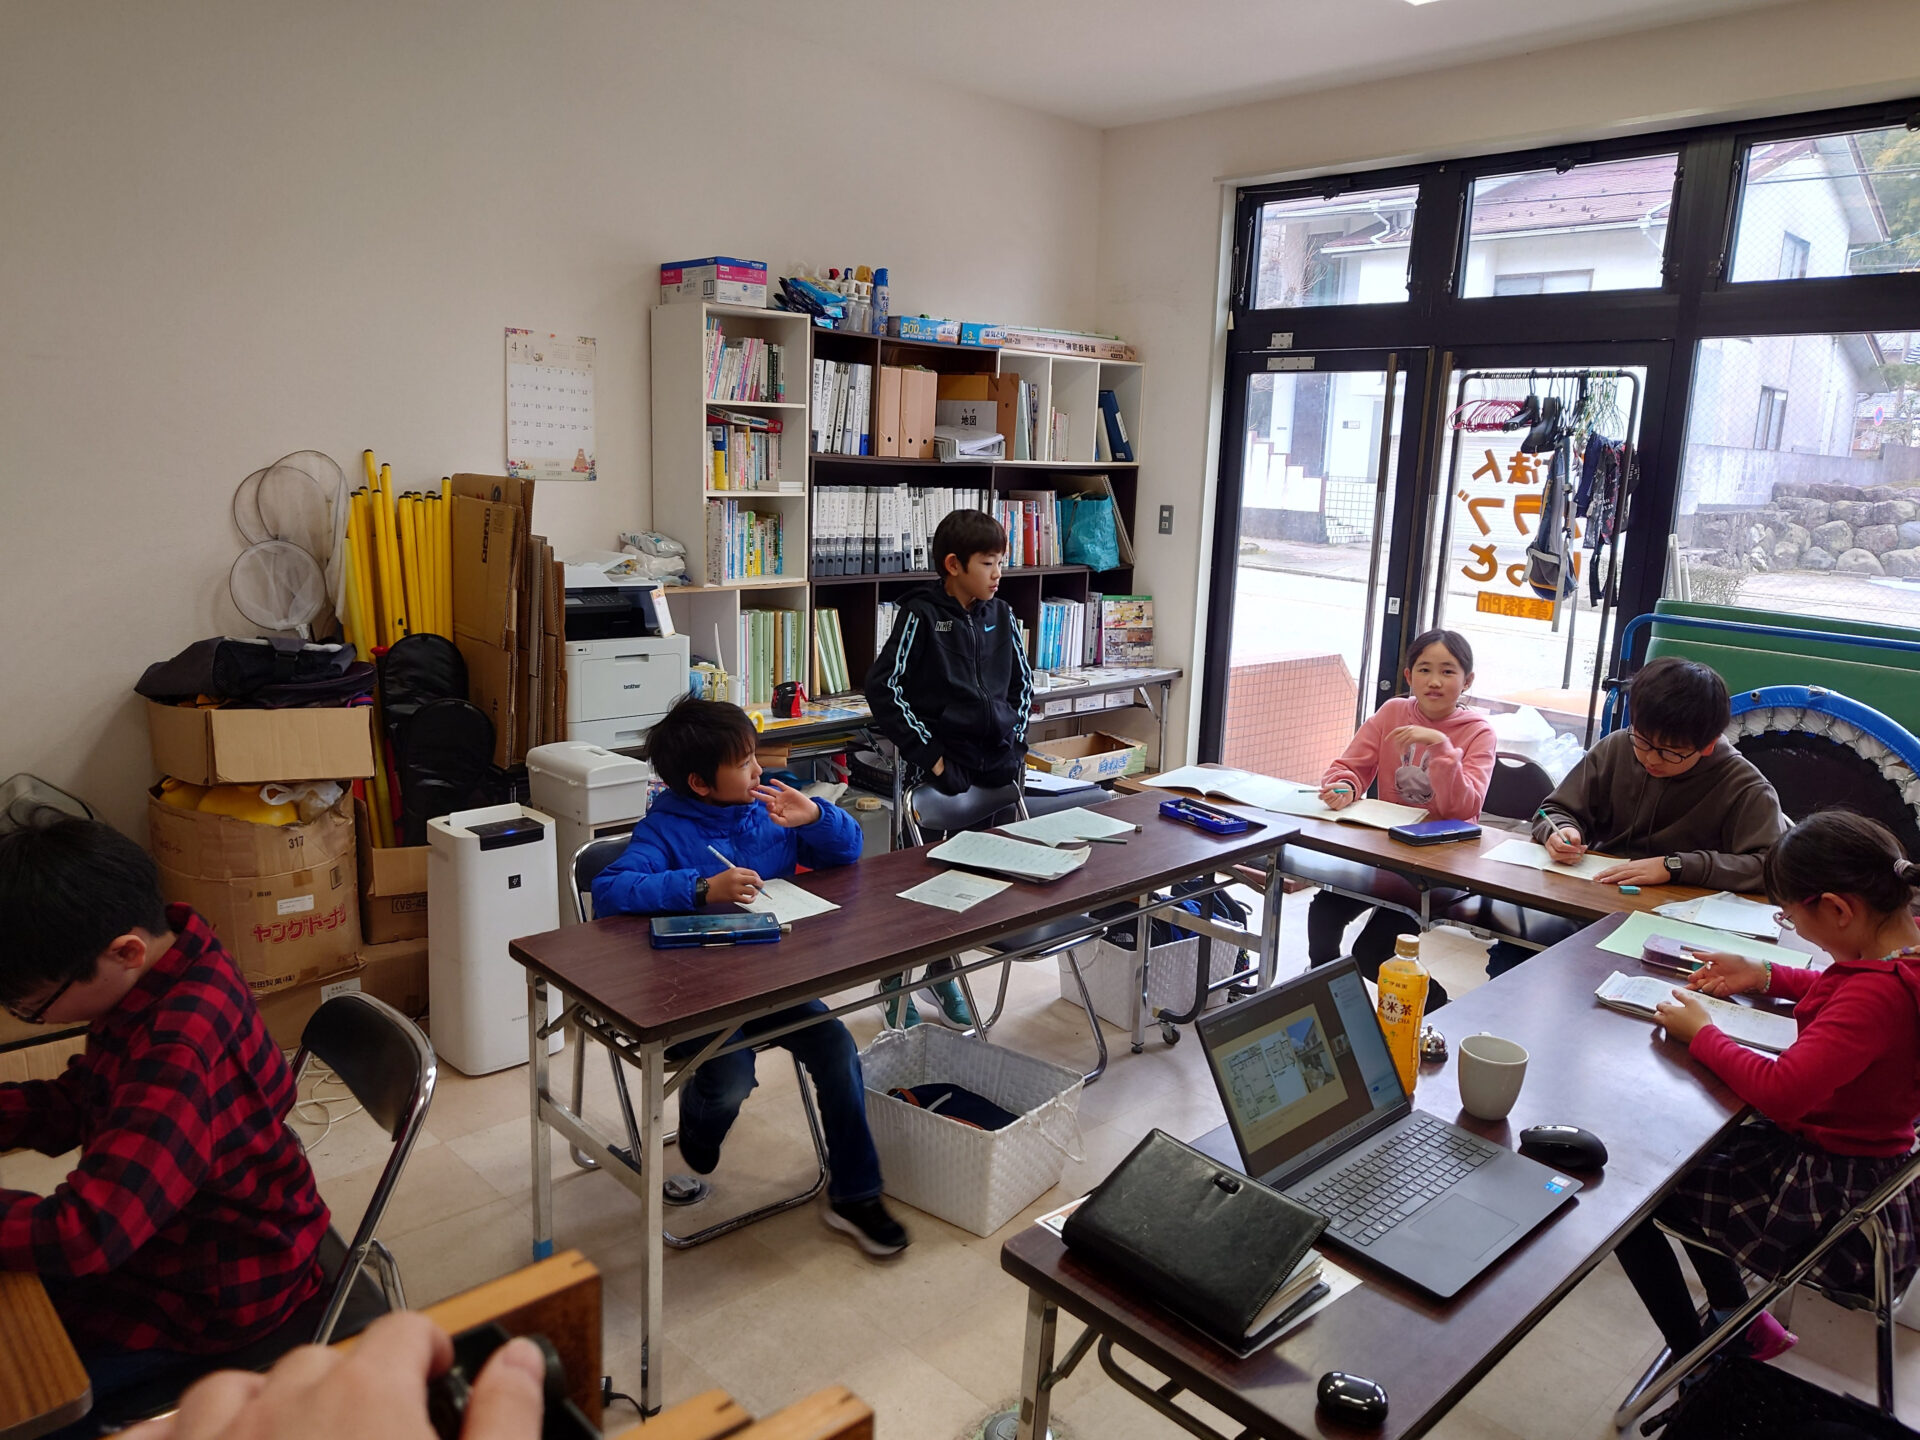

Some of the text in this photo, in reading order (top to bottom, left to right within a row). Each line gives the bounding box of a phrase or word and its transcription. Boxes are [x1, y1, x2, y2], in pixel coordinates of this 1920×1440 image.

[512, 342, 517, 352] 4
[961, 415, 977, 426] 地図
[935, 620, 953, 631] NIKE
[288, 835, 304, 849] 317
[253, 903, 347, 944] ヤングドーナツ
